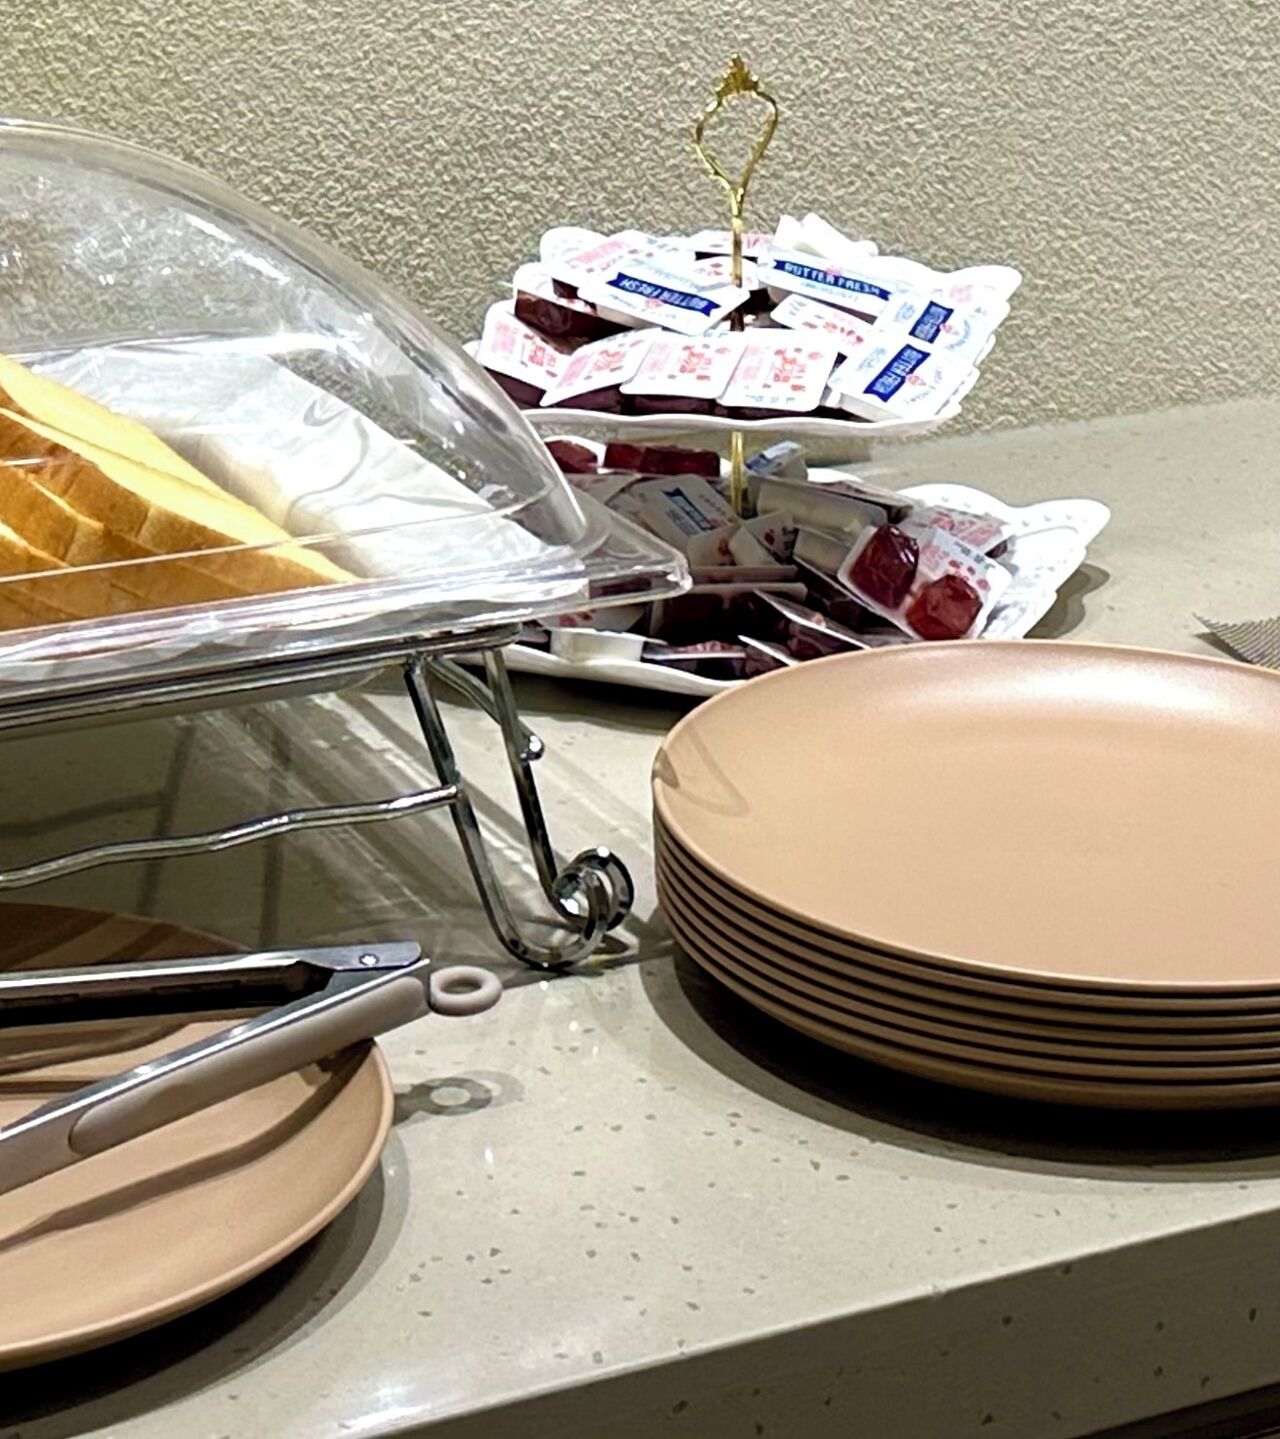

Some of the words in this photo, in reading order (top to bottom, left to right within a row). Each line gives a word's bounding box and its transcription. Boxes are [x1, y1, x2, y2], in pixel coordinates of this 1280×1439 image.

[618, 278, 662, 299] FRESH
[783, 262, 835, 286] BUTTER
[837, 275, 881, 296] FRESH
[660, 290, 709, 310] BUTTER
